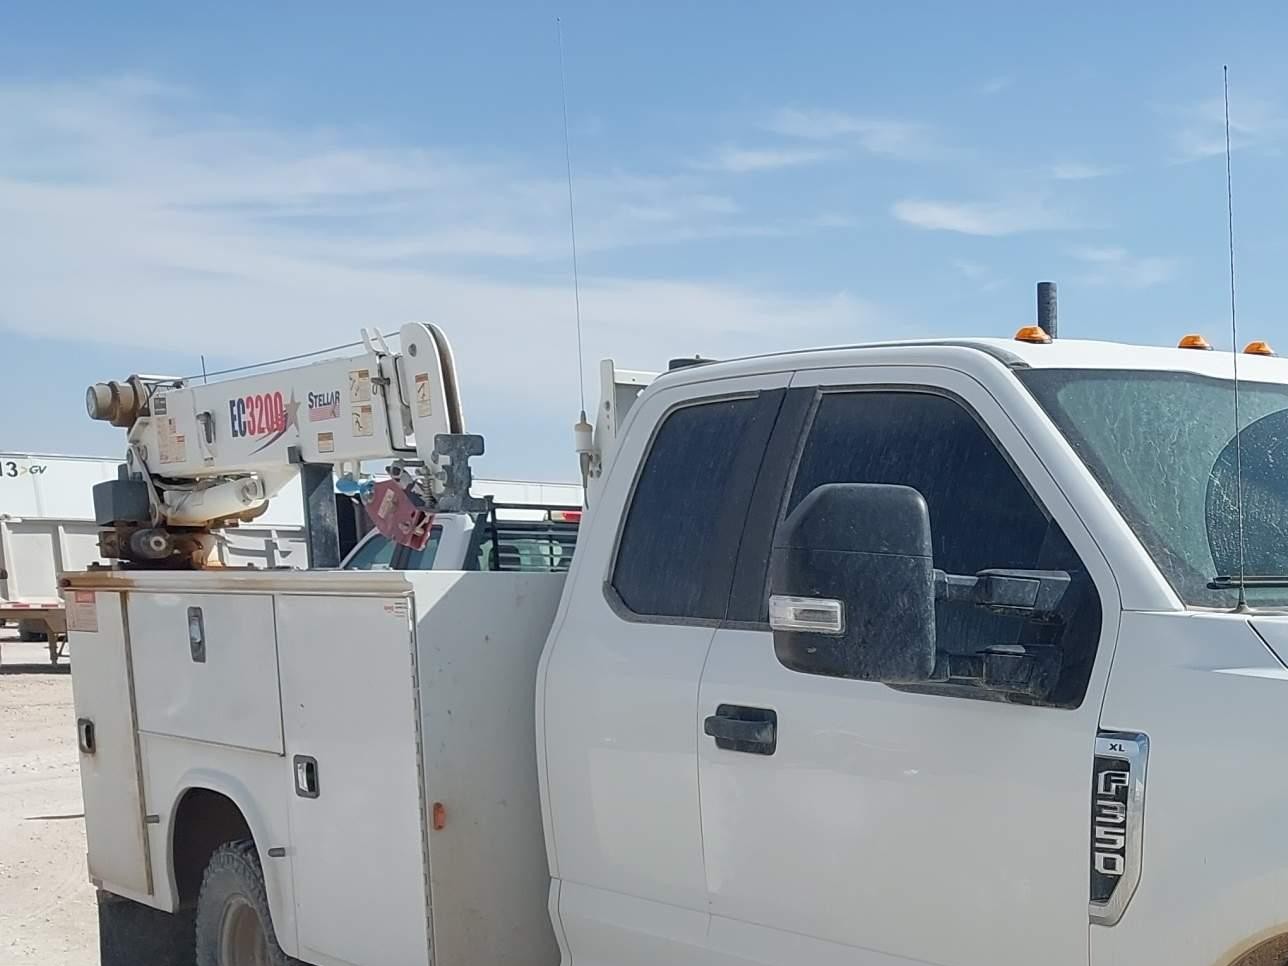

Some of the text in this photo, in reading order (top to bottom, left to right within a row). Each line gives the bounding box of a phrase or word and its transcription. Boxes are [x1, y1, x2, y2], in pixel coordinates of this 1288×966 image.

[229, 391, 287, 437] EC3200
[308, 391, 340, 409] STELLAR
[1109, 743, 1126, 752] XL
[1095, 771, 1130, 876] F350
